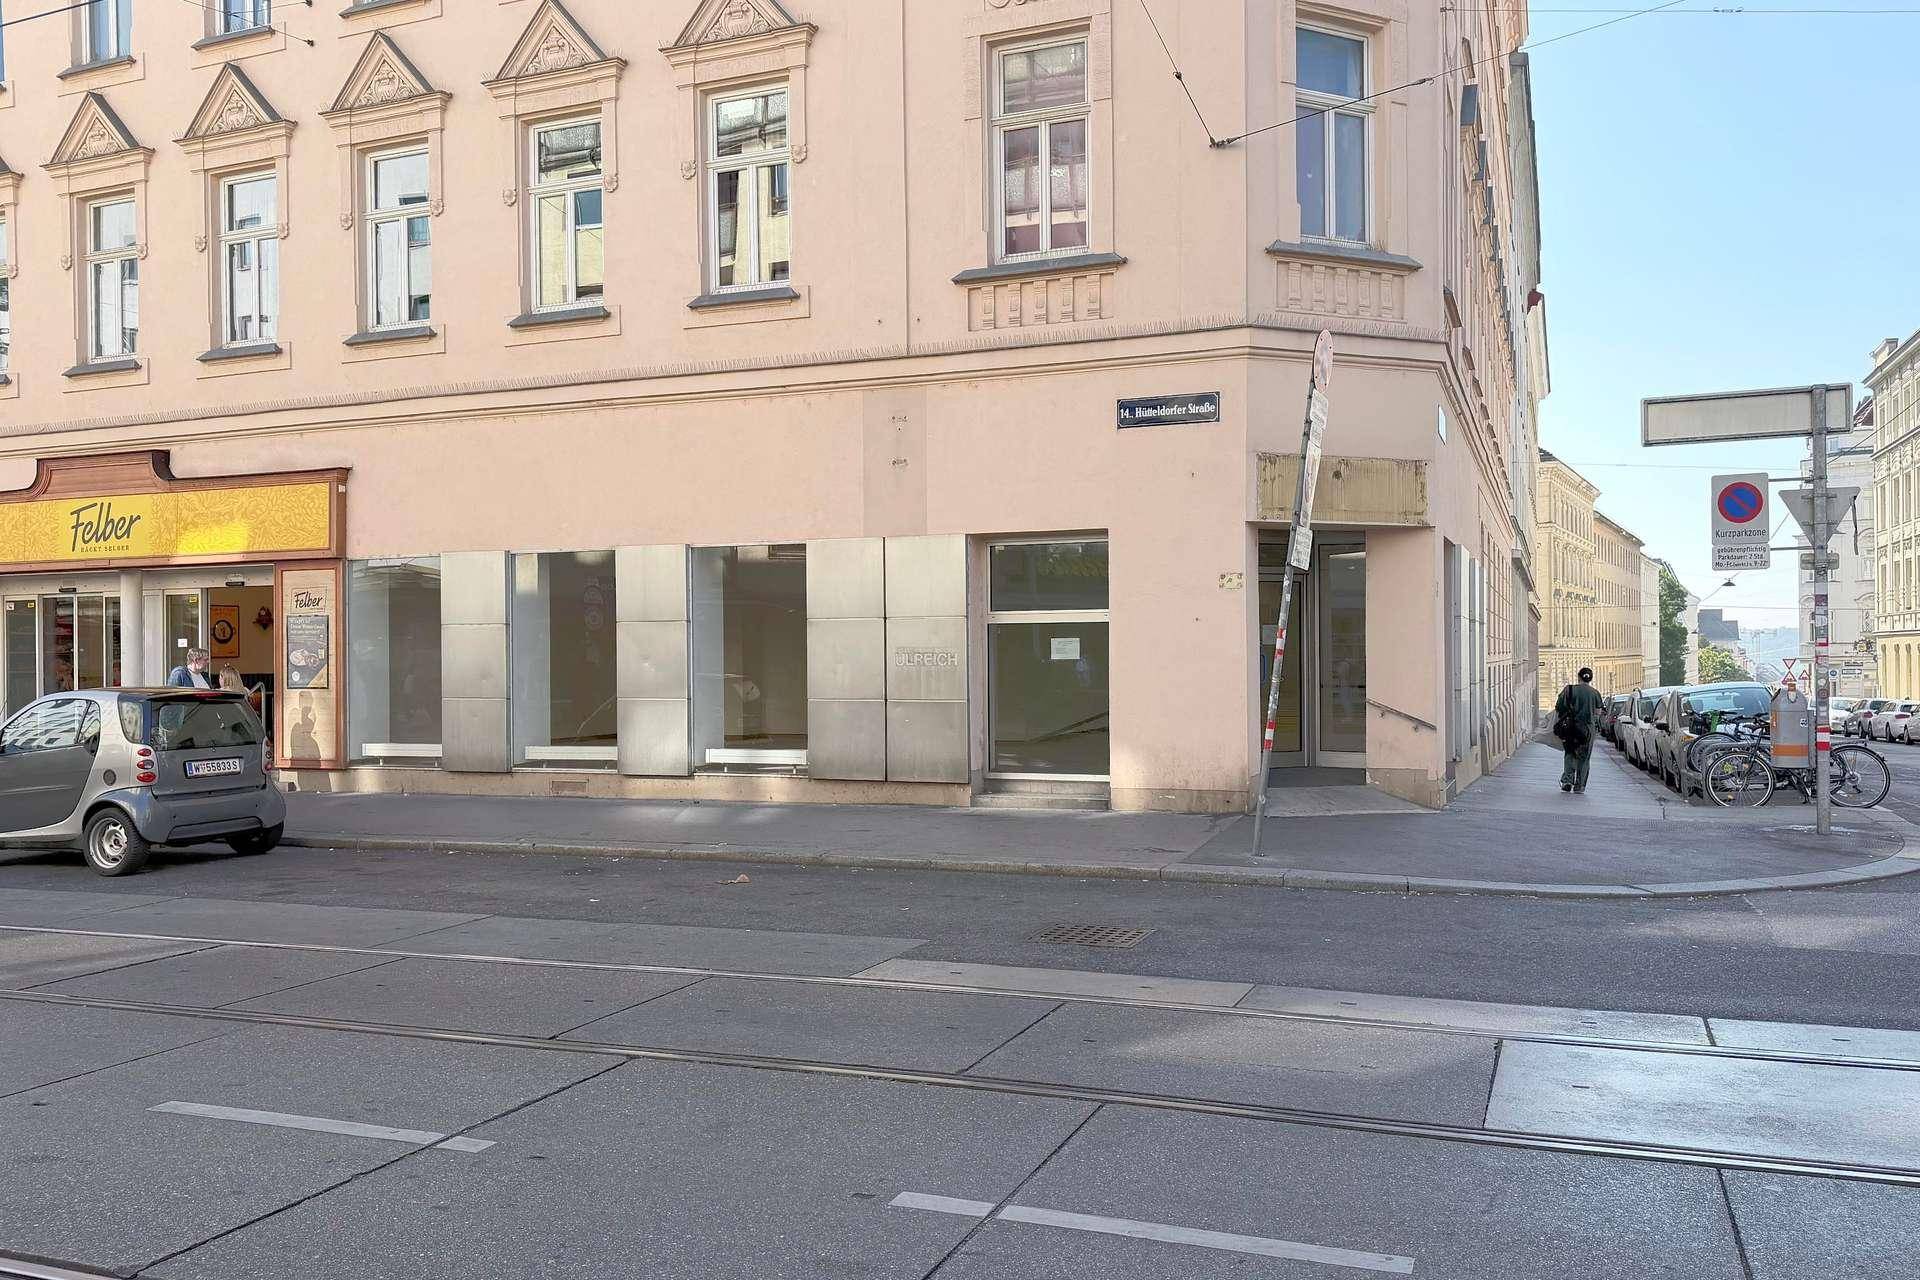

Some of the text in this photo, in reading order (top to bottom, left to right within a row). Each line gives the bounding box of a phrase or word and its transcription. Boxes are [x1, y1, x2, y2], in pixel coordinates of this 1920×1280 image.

[1135, 405, 1187, 418] Hütteldorfer
[1188, 402, 1216, 414] Straße
[70, 502, 141, 552] Felber
[1715, 528, 1767, 539] Kurzparkzone
[1717, 546, 1767, 554] gebührenpflichtig
[294, 591, 324, 609] Felber
[895, 652, 959, 667] ULREICH
